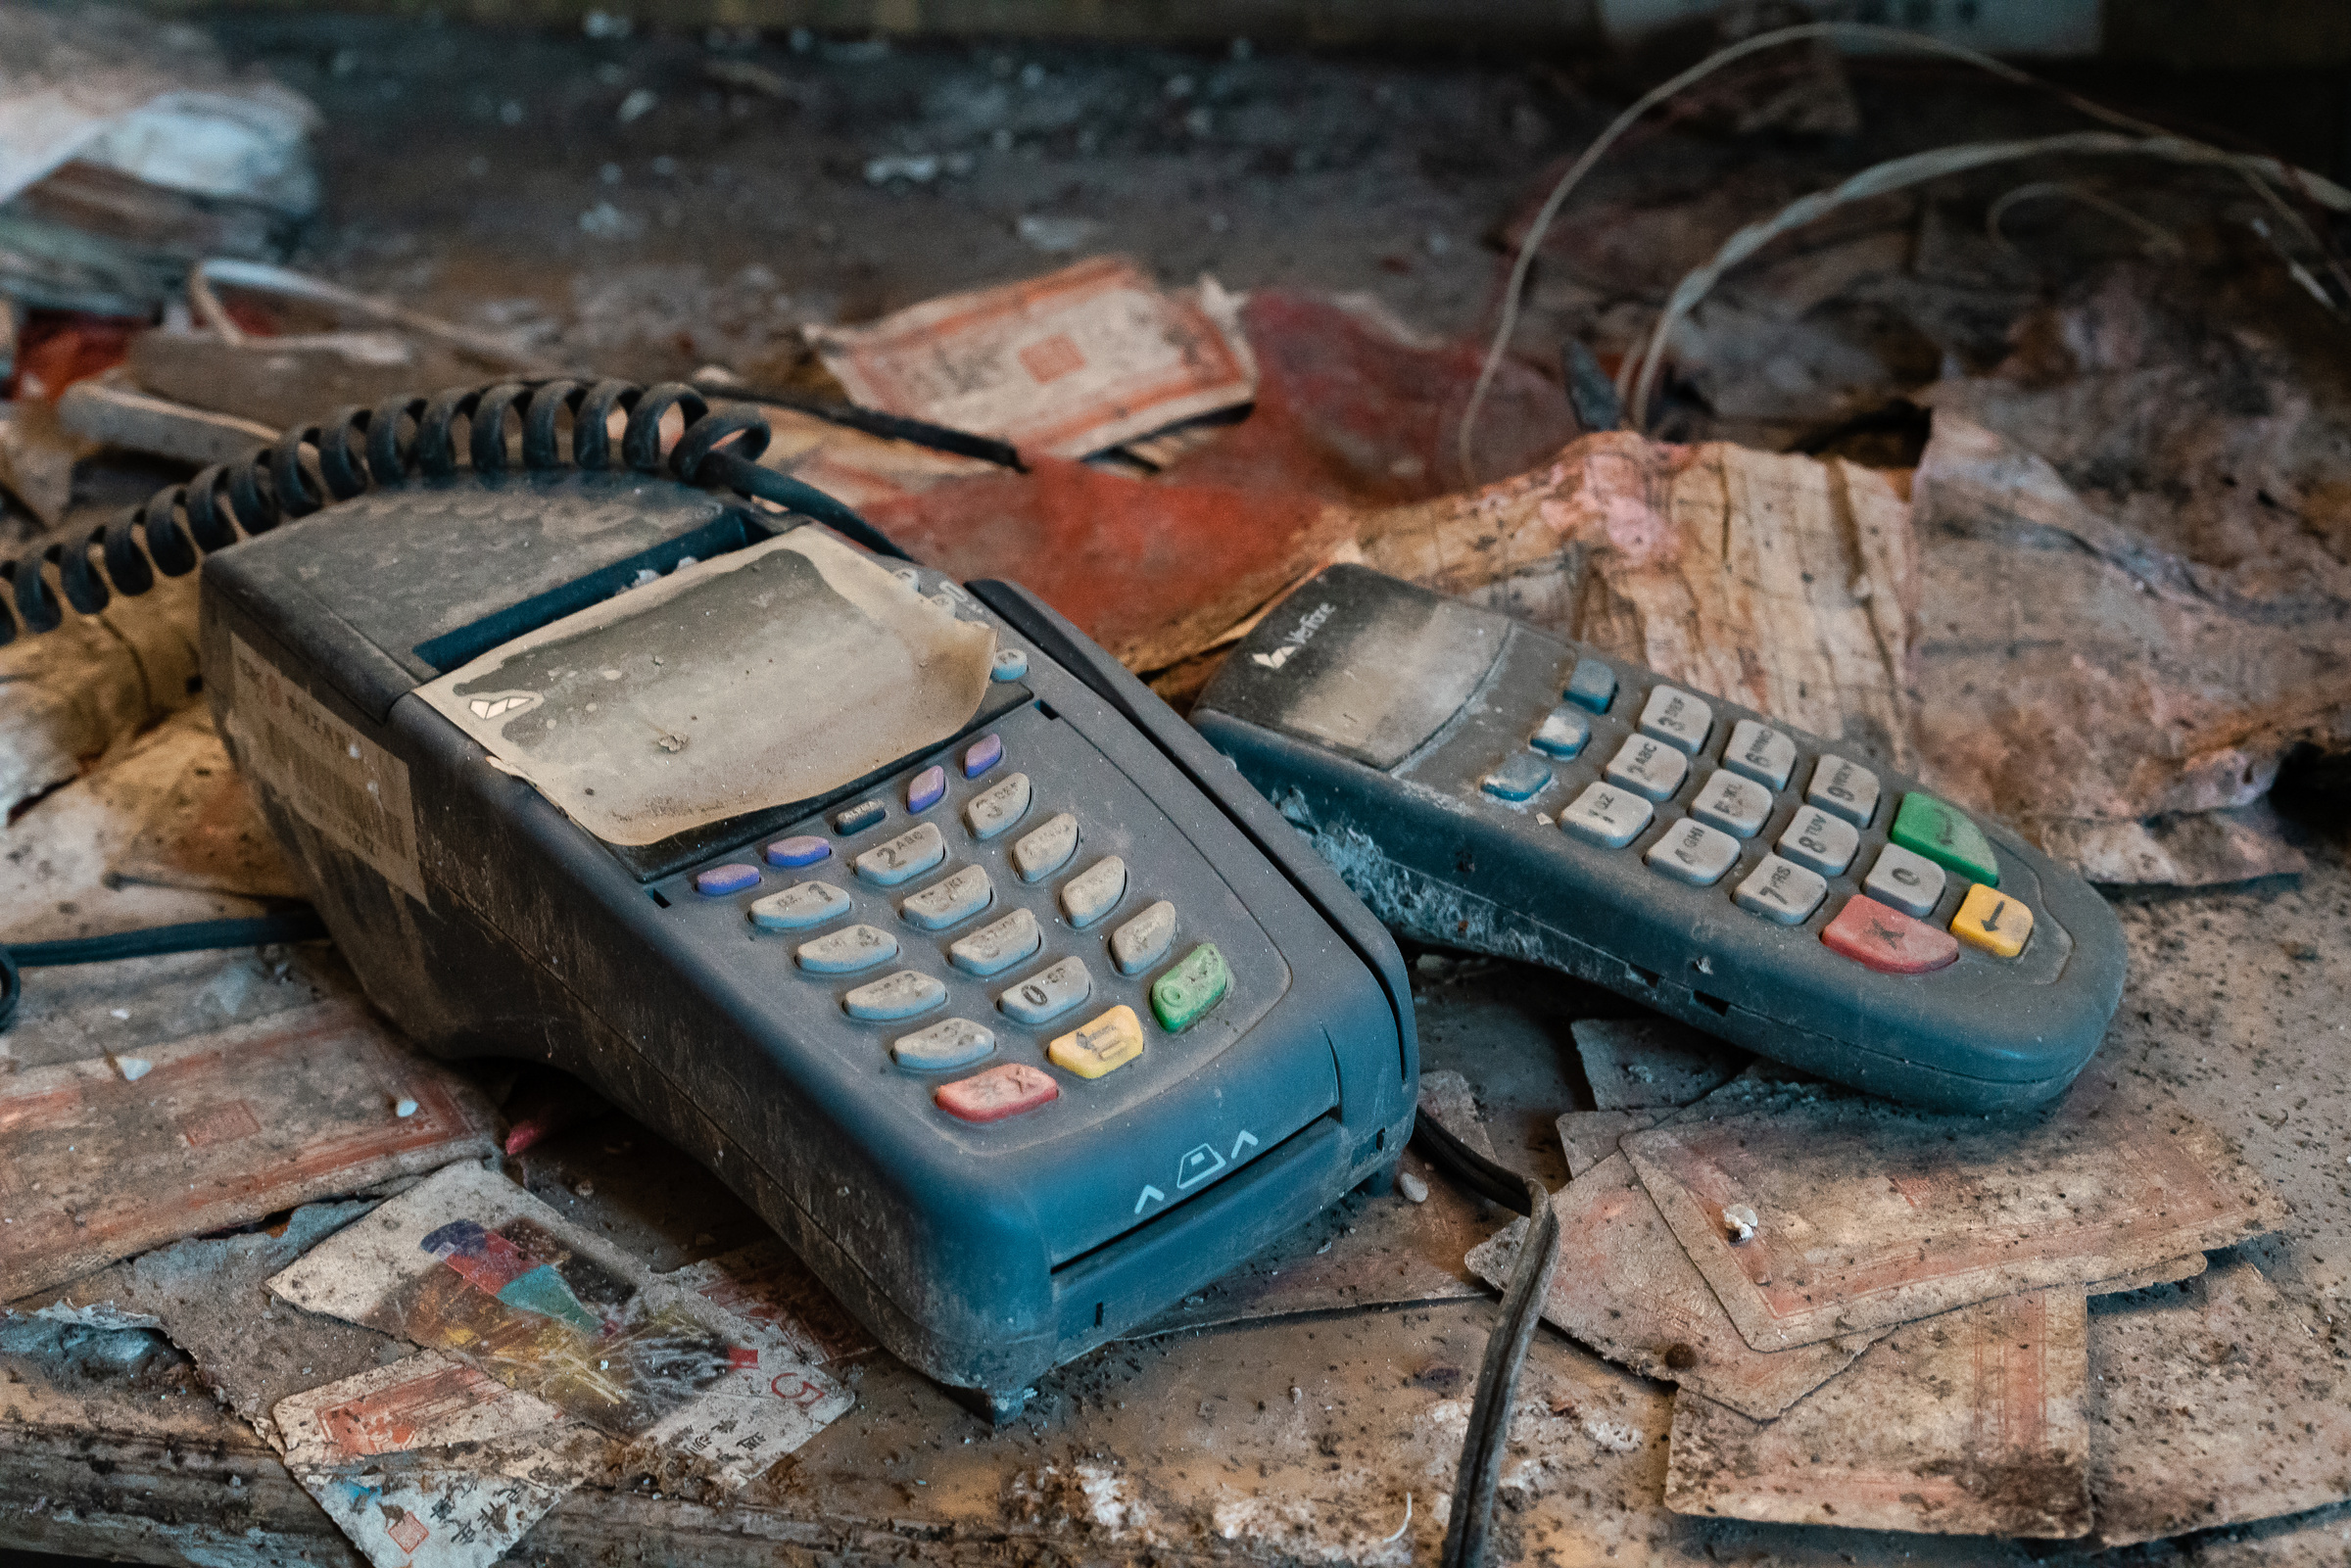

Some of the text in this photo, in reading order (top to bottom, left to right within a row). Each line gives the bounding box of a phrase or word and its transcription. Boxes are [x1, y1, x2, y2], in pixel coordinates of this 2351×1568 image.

[1657, 716, 1687, 732] 3
[1827, 784, 1855, 803] 9
[1683, 826, 1706, 850] GHI
[1798, 837, 1828, 855] 8
[876, 846, 907, 870] 2
[1892, 868, 1921, 886] 0
[1759, 884, 1789, 905] 7
[1021, 984, 1048, 1006] 0
[770, 1372, 826, 1409] 5
